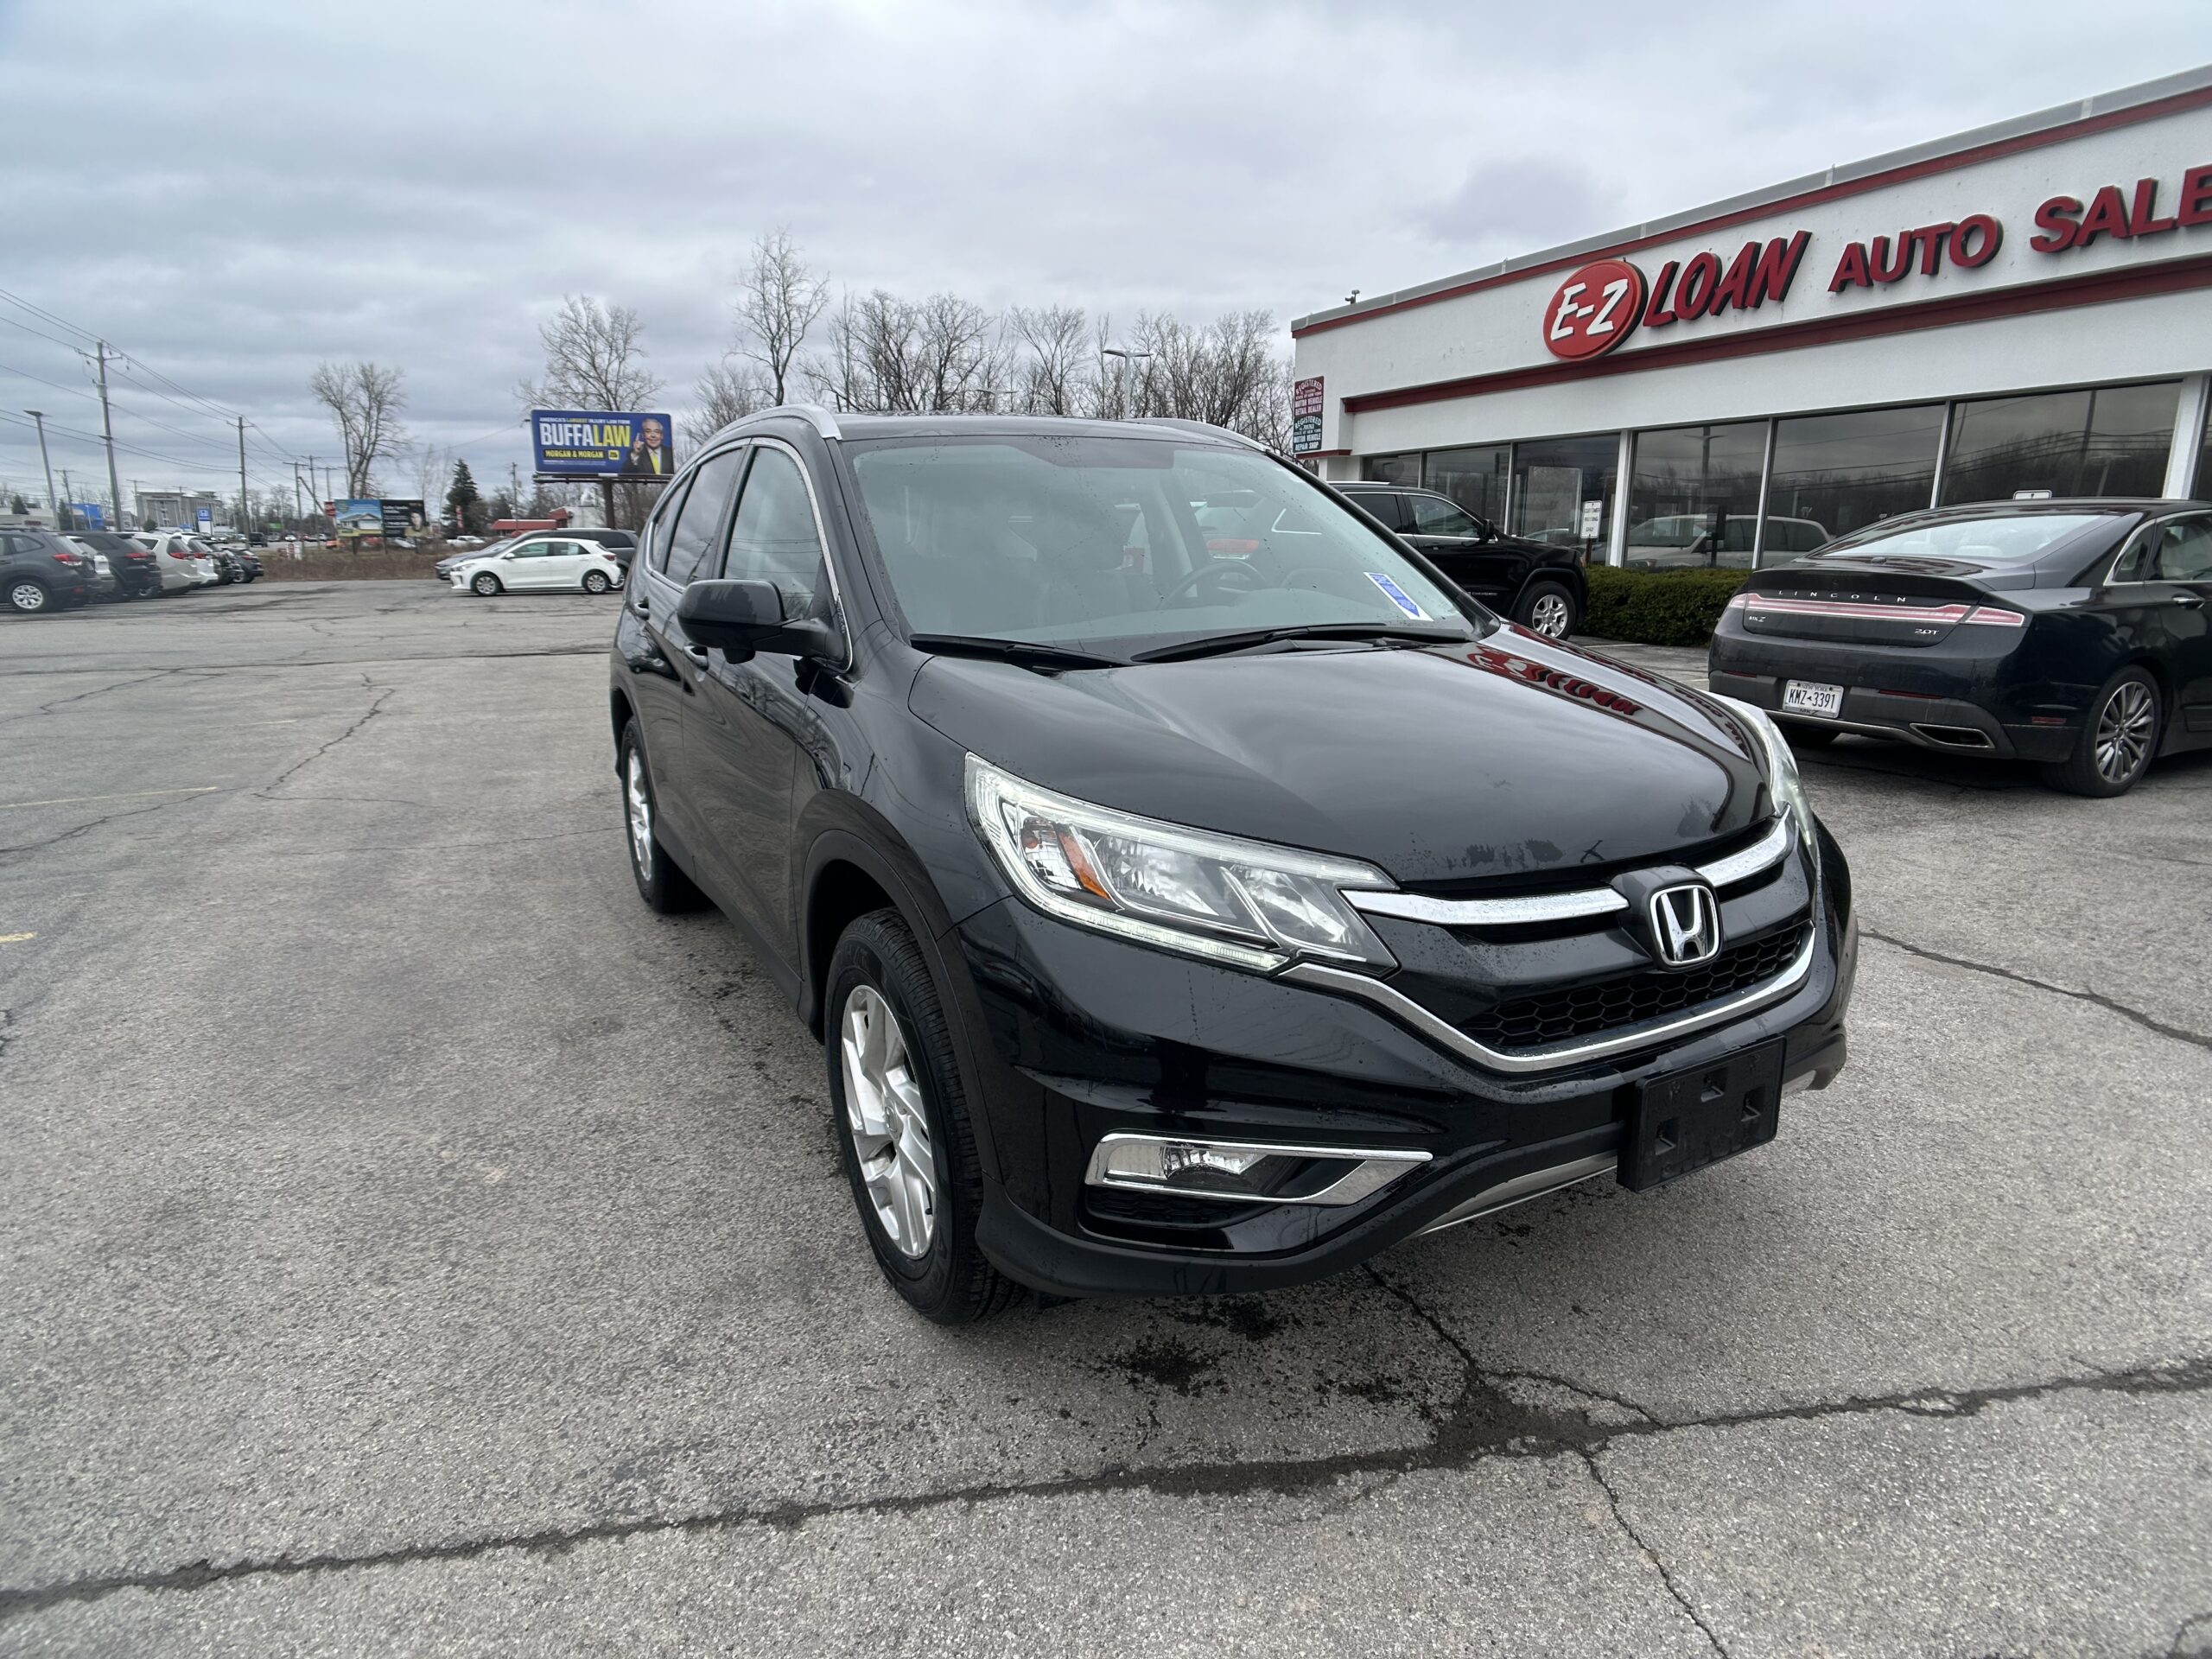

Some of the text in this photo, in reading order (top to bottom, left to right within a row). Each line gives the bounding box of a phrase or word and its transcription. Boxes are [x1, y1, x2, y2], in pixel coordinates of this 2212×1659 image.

[1550, 279, 1628, 340] E-Z
[1643, 230, 1812, 327] LOAN
[1827, 213, 2003, 292] AUTO
[1296, 379, 1322, 395] REGISTERED
[1307, 395, 1322, 405] VEHICLE
[1295, 416, 1321, 430] REGISTERED
[539, 423, 631, 448] BUFFALAW
[1294, 433, 1320, 443] MOTOR VEHICLE
[545, 449, 571, 458] MORGAN
[578, 450, 604, 459] MORGAN
[1778, 590, 1906, 603] LINCOLN
